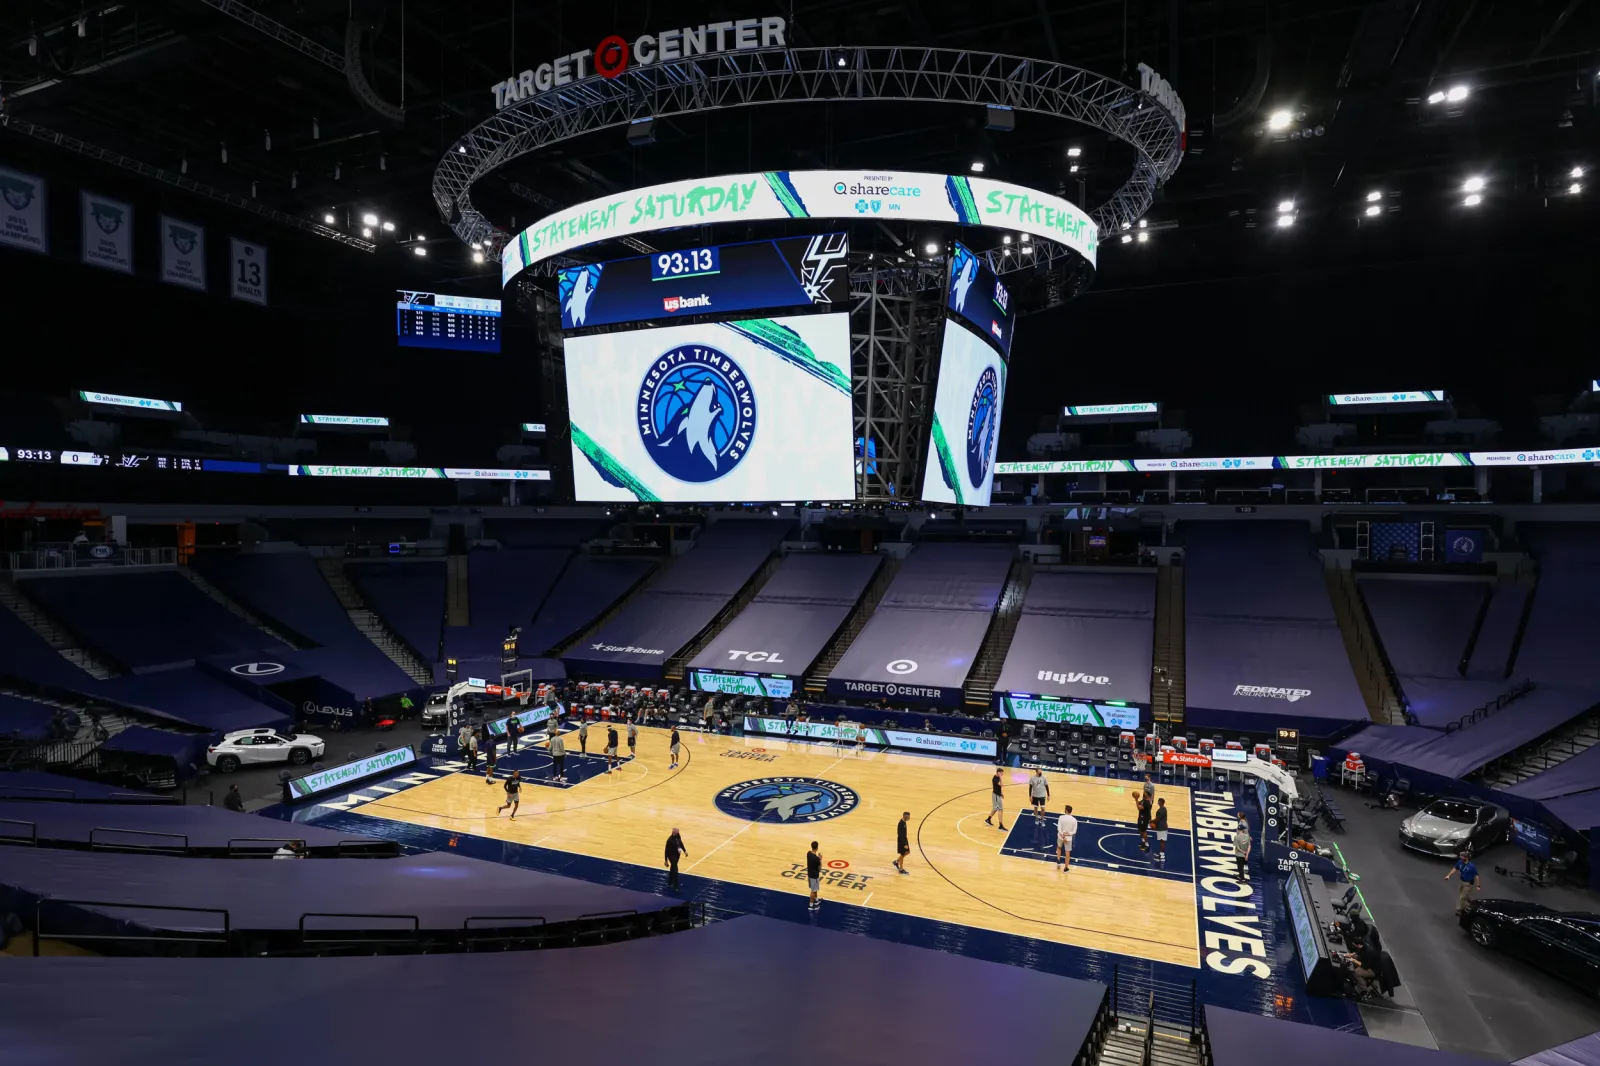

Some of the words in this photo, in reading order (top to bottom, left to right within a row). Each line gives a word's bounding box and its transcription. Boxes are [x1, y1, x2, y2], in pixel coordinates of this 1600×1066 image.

[491, 48, 593, 110] TARGET
[633, 16, 786, 65] CENTER
[850, 181, 921, 196] sharecare
[888, 203, 901, 211] MN
[533, 200, 625, 252] STATEMENT
[629, 180, 758, 225] SATURDAY
[985, 190, 1088, 243] STATEMENT
[658, 248, 713, 275] 93:13
[237, 259, 261, 287] 13
[237, 283, 262, 297] WHALEN
[640, 351, 686, 435] MINNESOTA
[693, 349, 753, 460] TIMBERWOLVES
[1351, 394, 1387, 402] sharecare
[968, 371, 991, 441] MINNESOTA
[1117, 404, 1148, 412] SATURDAY
[17, 449, 52, 460] 93:13
[72, 454, 78, 462] 0
[1296, 456, 1368, 468] STATEMENT
[1374, 453, 1444, 466] SATURDAY
[1527, 452, 1576, 462] sharecare
[999, 461, 1054, 473] STATEMENT
[1060, 460, 1114, 472] SATURDAY
[1178, 460, 1218, 468] sharecare
[317, 466, 373, 476] STATEMENT
[378, 467, 428, 477] SATURDAY
[728, 649, 784, 663] TCL
[702, 674, 745, 684] STATEMENT
[1037, 670, 1109, 685] HyVee
[718, 684, 756, 695] SATURDAY
[845, 682, 885, 693] TARGET
[898, 686, 941, 698] CENTER
[1233, 690, 1287, 699] INSURANCE
[1235, 684, 1312, 697] FEDERATED
[316, 705, 353, 717] LEXUS
[1016, 700, 1072, 713] STATEMENT
[1036, 710, 1089, 724] SATURDAY
[922, 738, 957, 748] sharecare
[719, 752, 774, 762] CENTER
[727, 749, 780, 758] TARGET
[311, 764, 363, 788] STATEMENT
[366, 749, 406, 773] SATURDAY
[721, 777, 805, 798] MINNESOTA
[807, 779, 854, 821] TIMBERWOLVES
[781, 870, 867, 890] CETER
[791, 863, 873, 883] TRGET
[1194, 790, 1271, 979] TIMBERWOLVES
